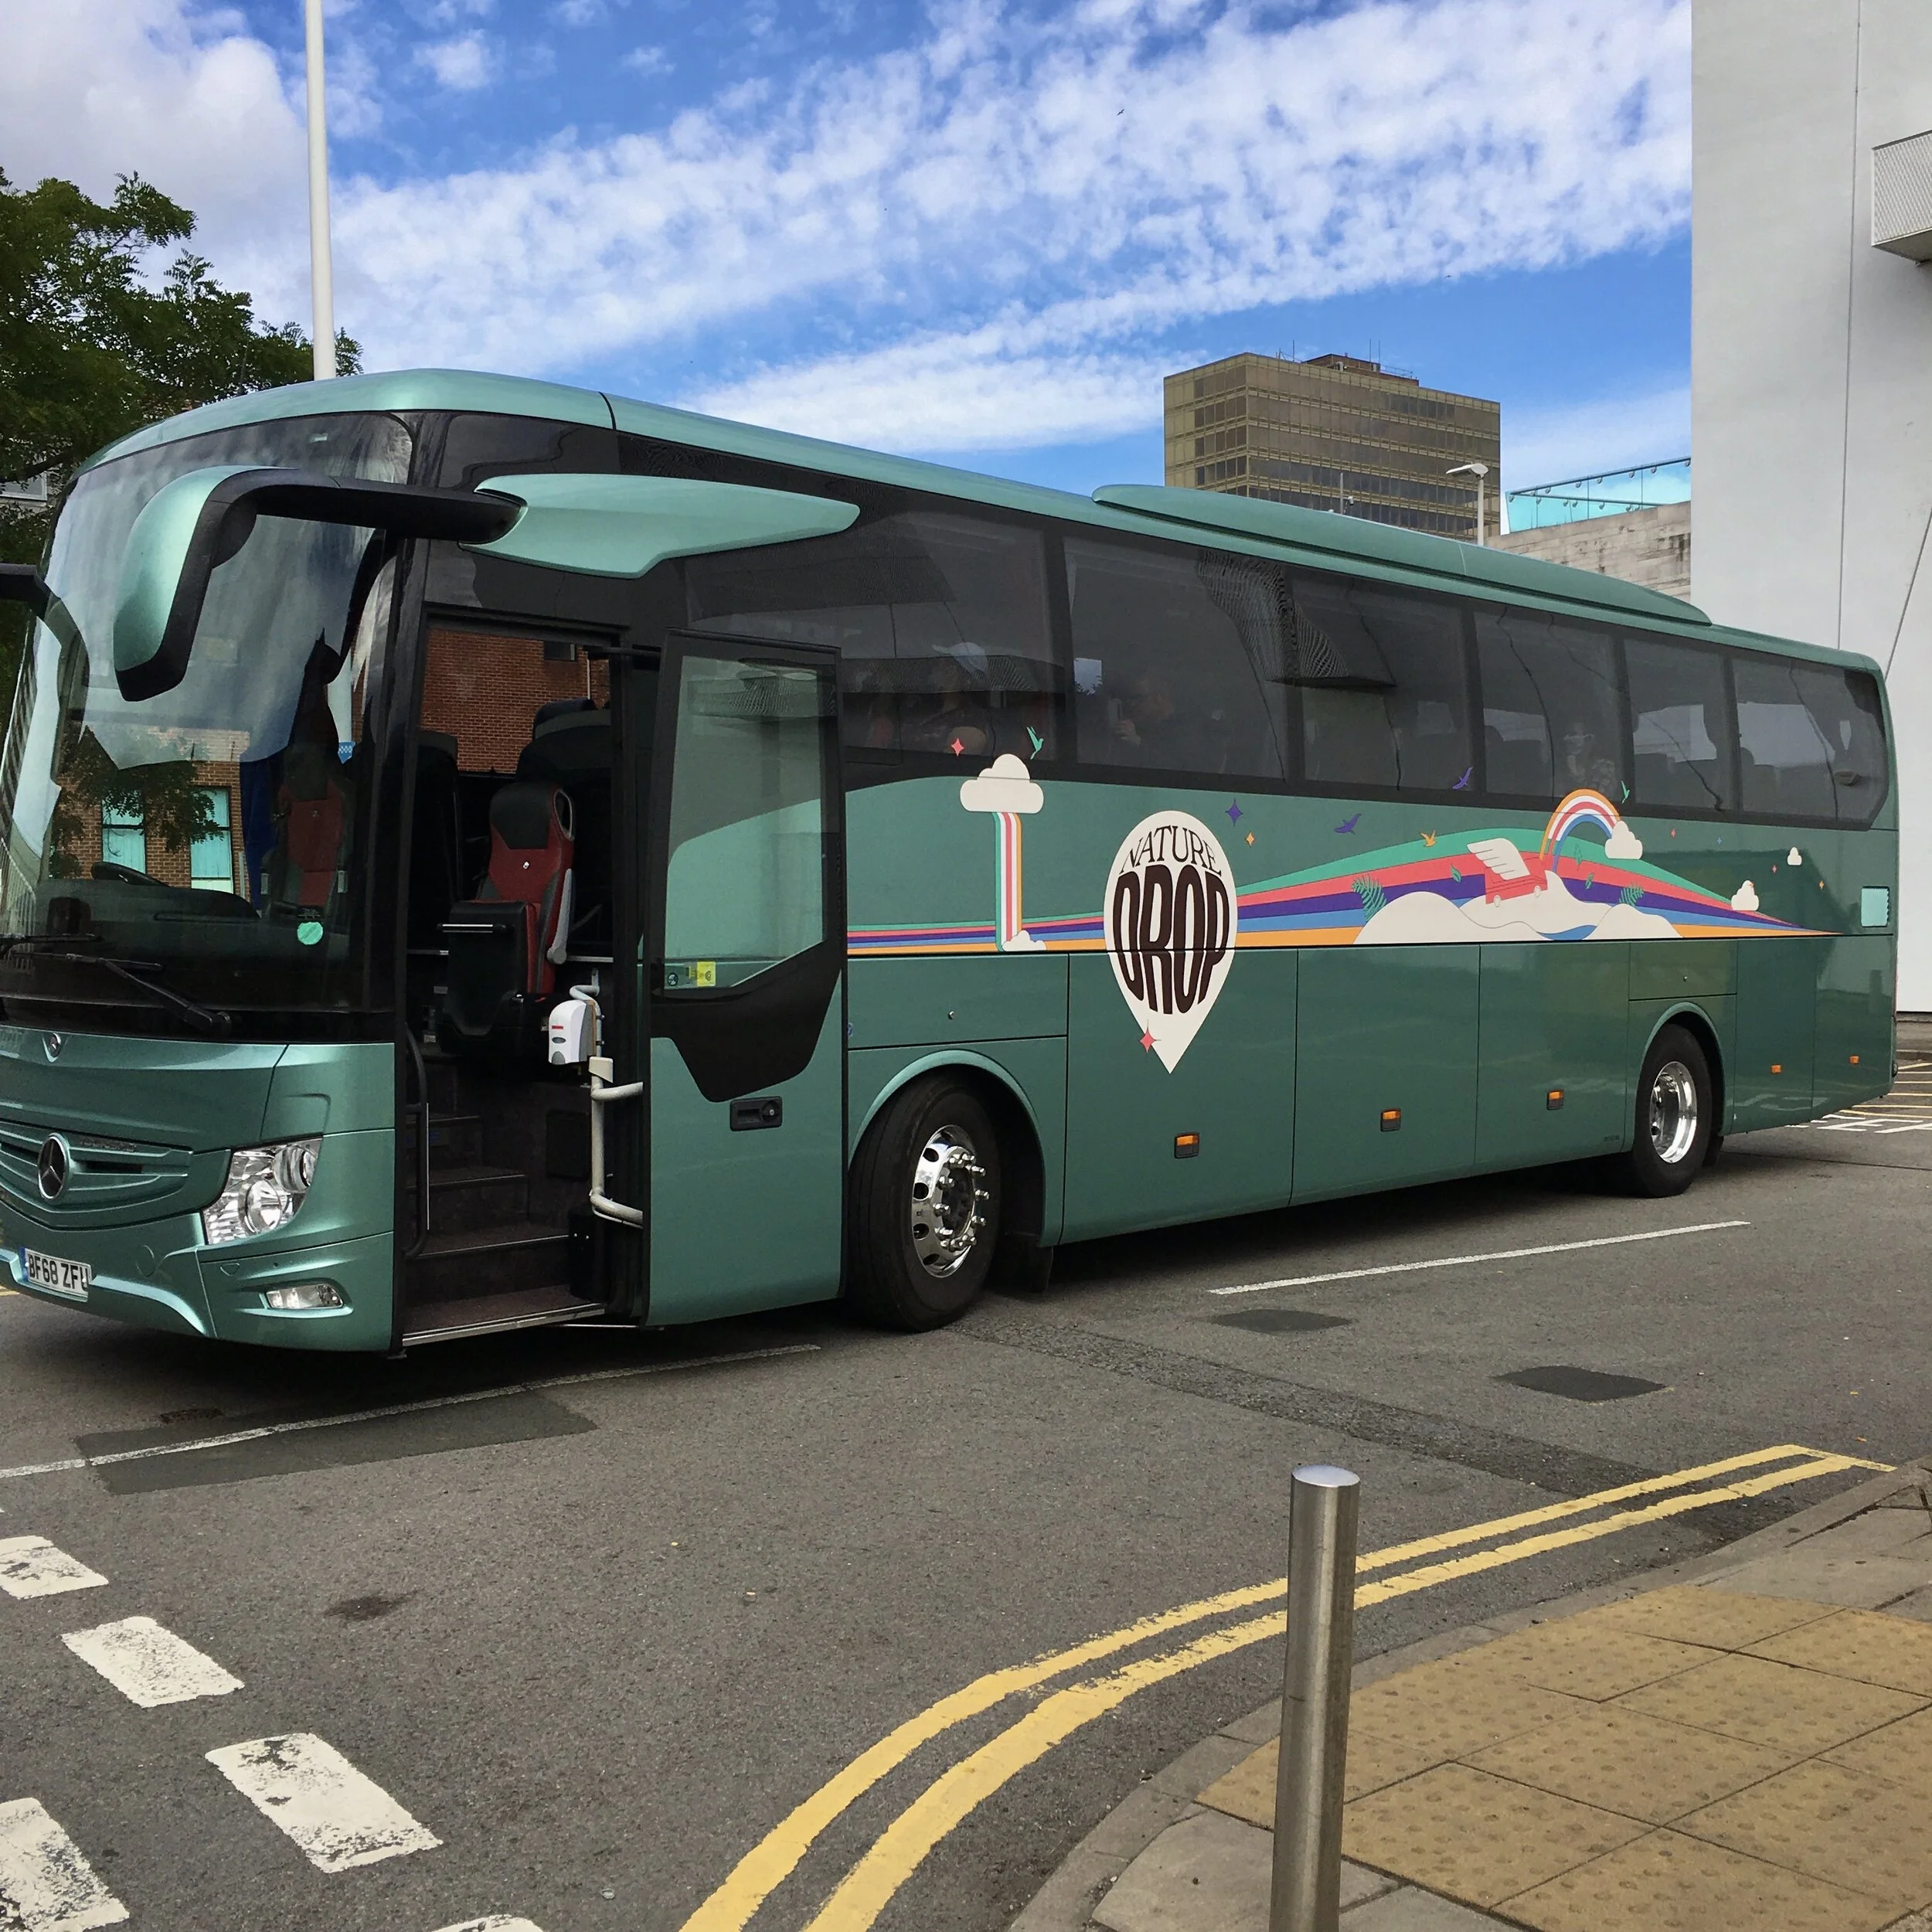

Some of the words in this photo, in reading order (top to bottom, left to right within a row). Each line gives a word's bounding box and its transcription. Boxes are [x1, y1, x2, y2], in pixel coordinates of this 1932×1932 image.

[1119, 825, 1222, 876] NATURE
[1113, 864, 1230, 1015] DROP
[28, 1253, 59, 1285] BF68
[60, 1262, 90, 1292] ZFU
